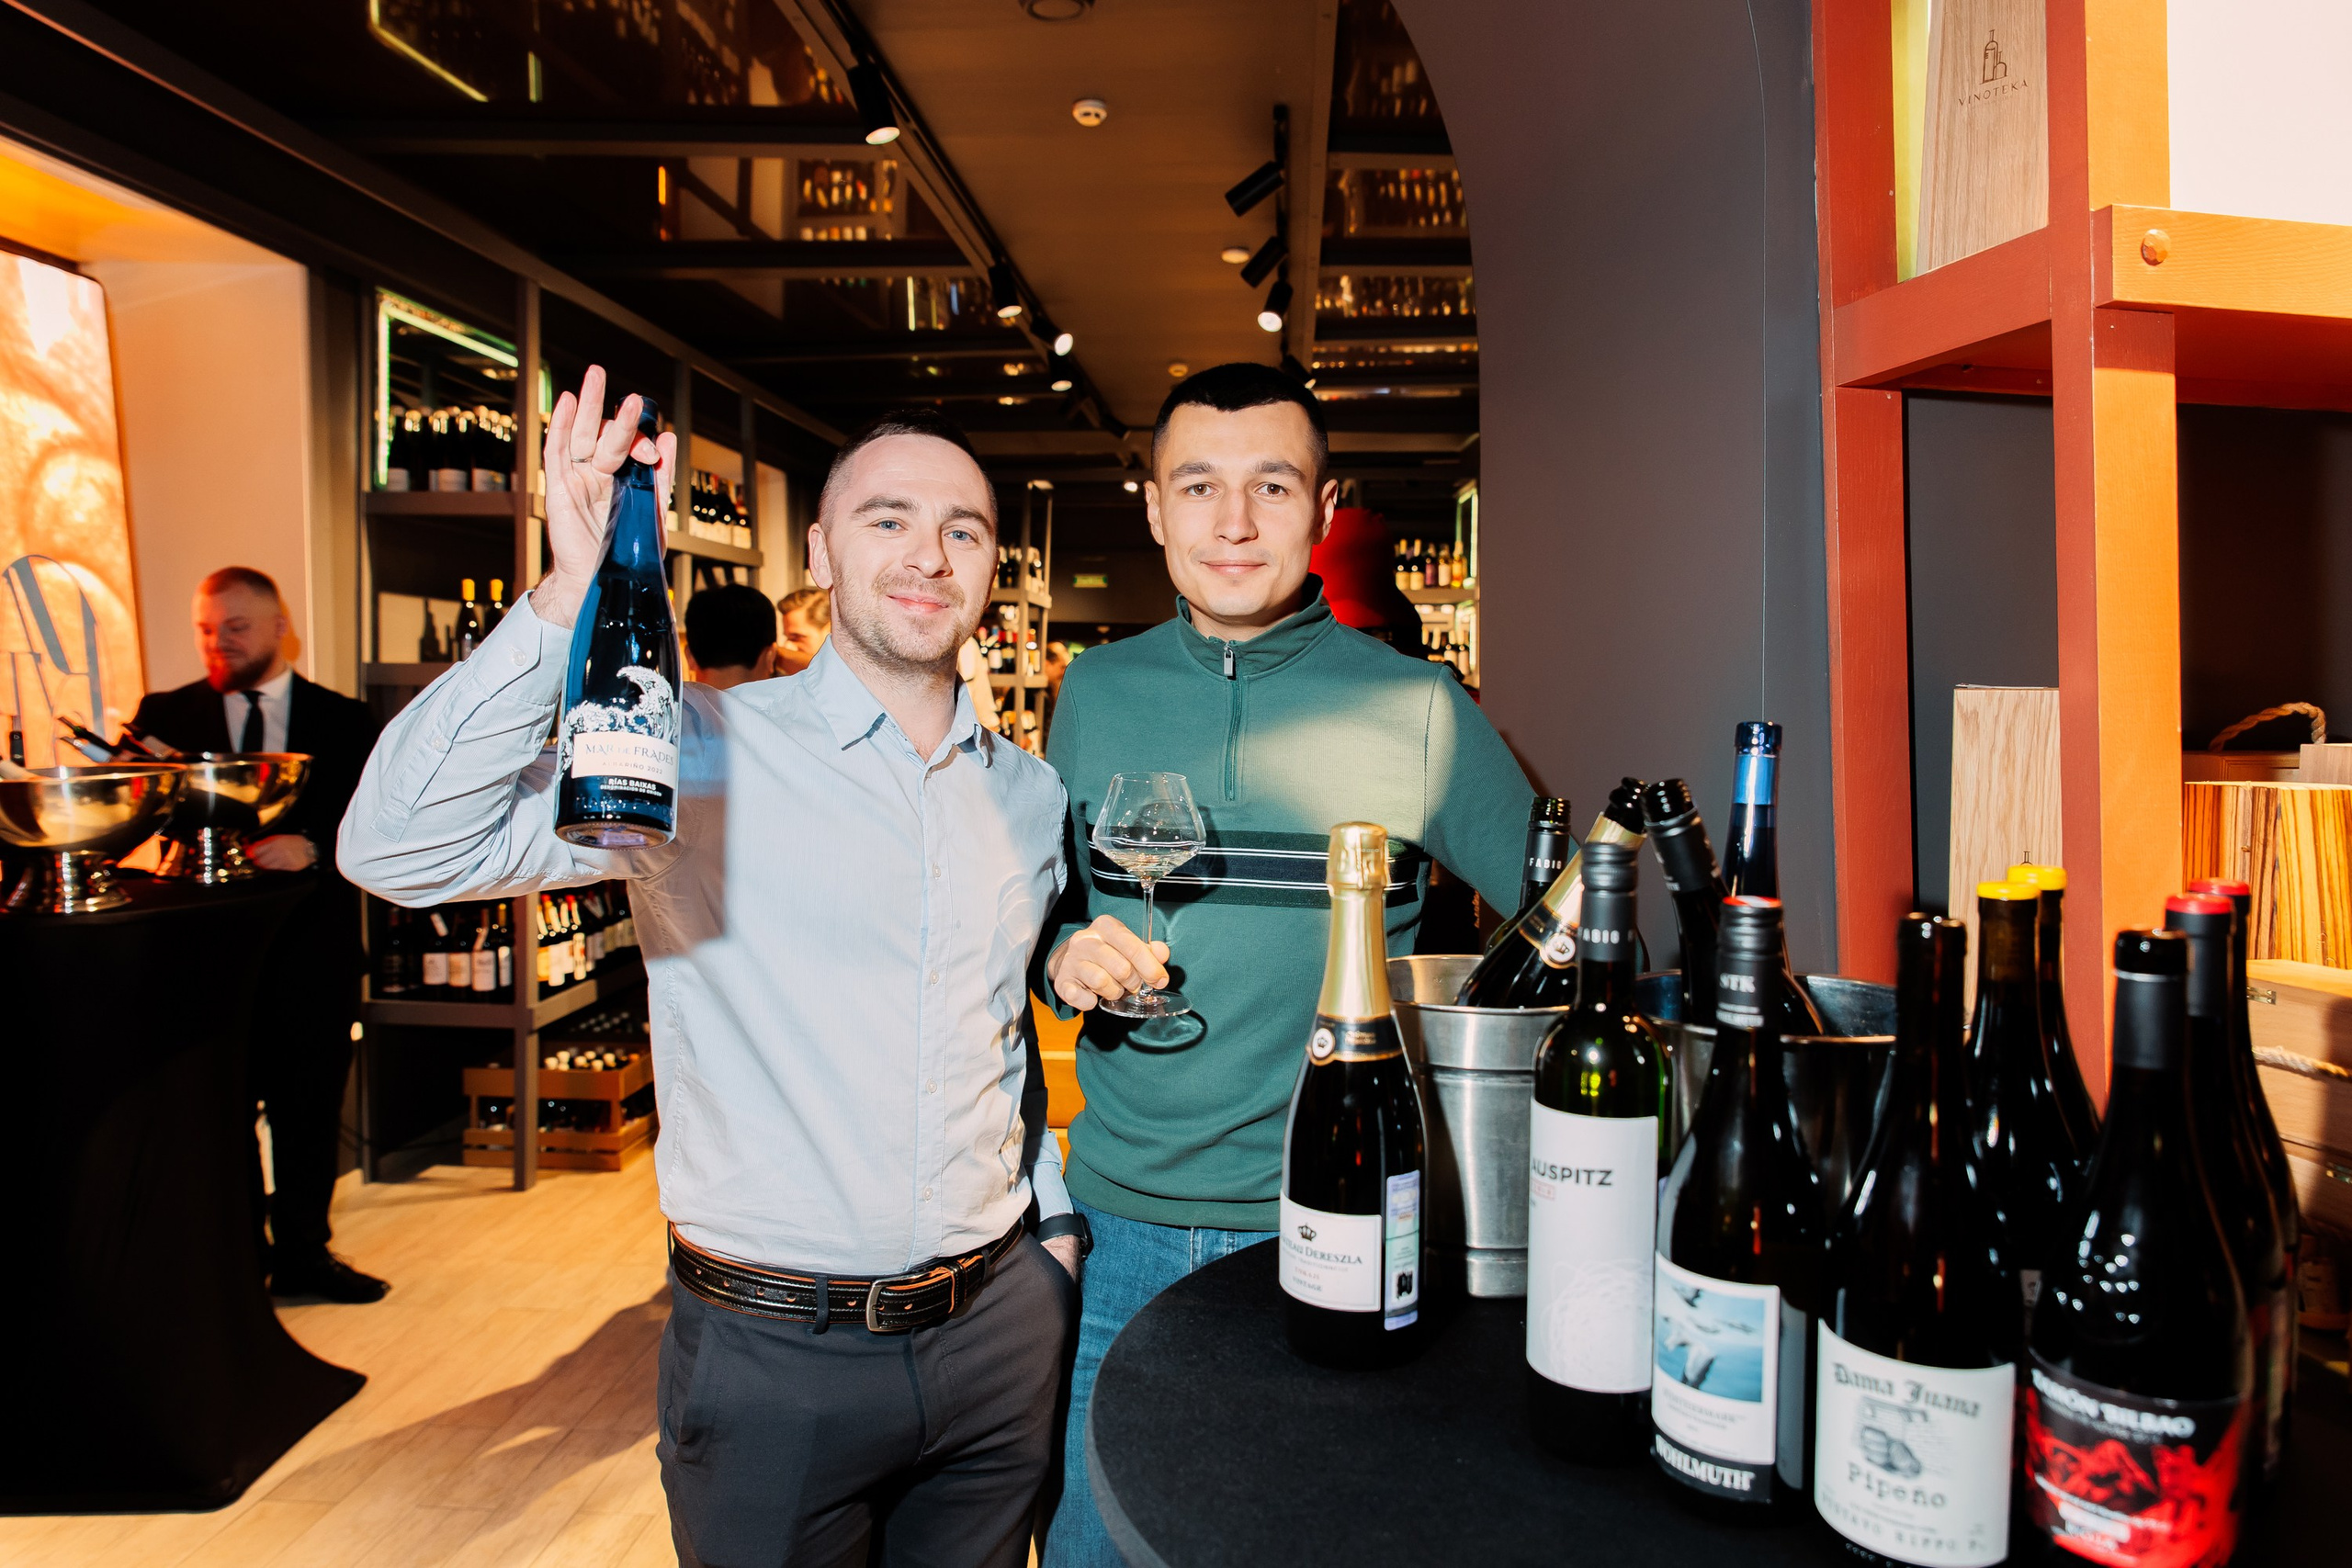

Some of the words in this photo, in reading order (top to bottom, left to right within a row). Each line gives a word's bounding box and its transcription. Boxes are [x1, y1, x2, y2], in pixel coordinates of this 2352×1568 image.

[1958, 79, 2029, 107] VINOTEKA
[585, 743, 615, 756] MAR
[634, 746, 674, 766] FRADES
[608, 777, 628, 787] RÍAS
[628, 779, 657, 791] BAIXAS
[1529, 857, 1562, 870] FABIO
[1720, 973, 1756, 993] STK
